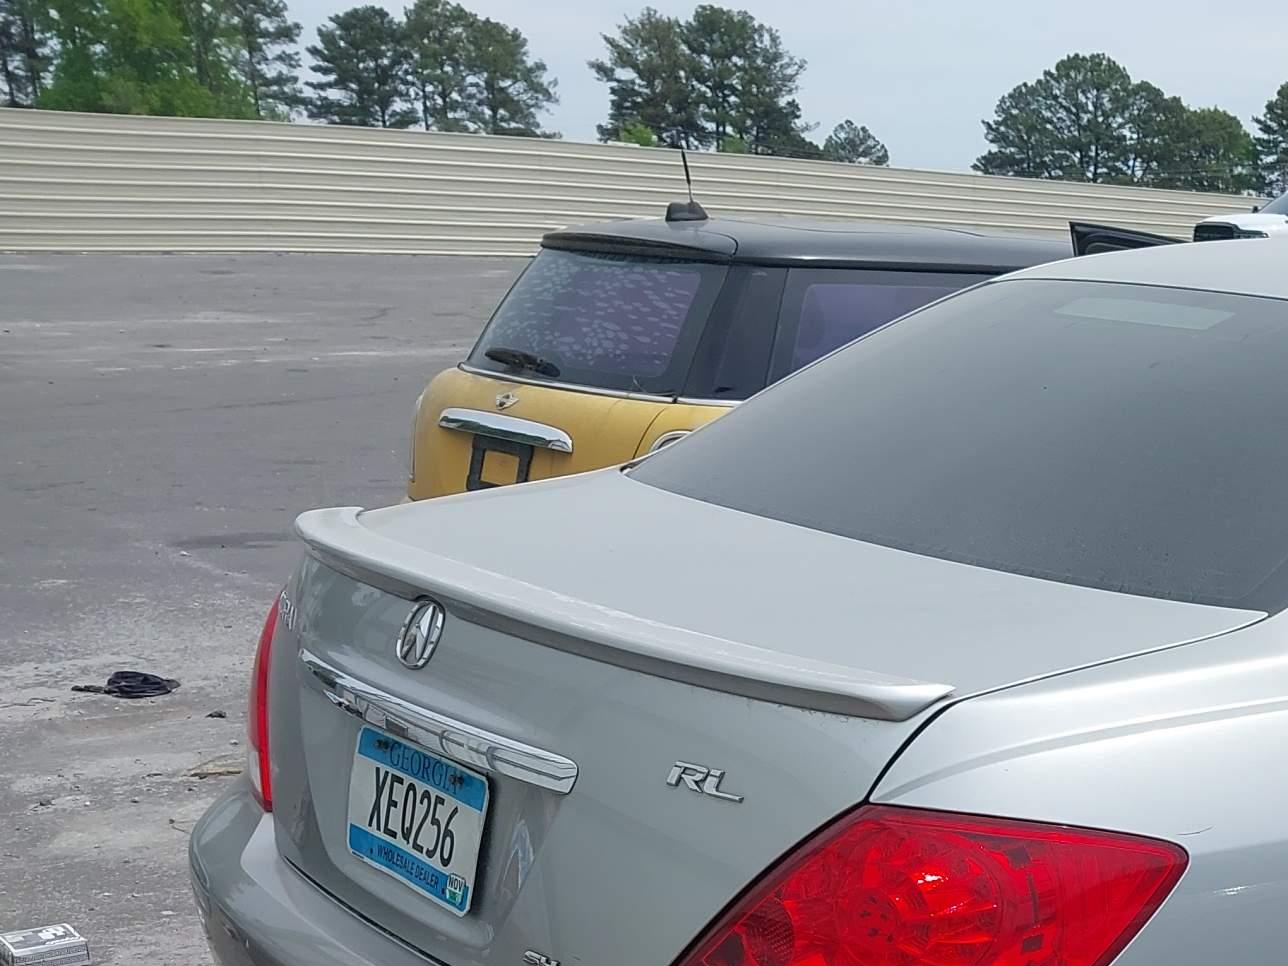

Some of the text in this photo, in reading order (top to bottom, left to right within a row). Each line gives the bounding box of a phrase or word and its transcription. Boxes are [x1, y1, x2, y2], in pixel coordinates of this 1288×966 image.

[666, 760, 745, 804] RL
[367, 766, 459, 868] XEQ256
[376, 844, 439, 889] WHOLESALE DEALER
[448, 874, 464, 893] NOV
